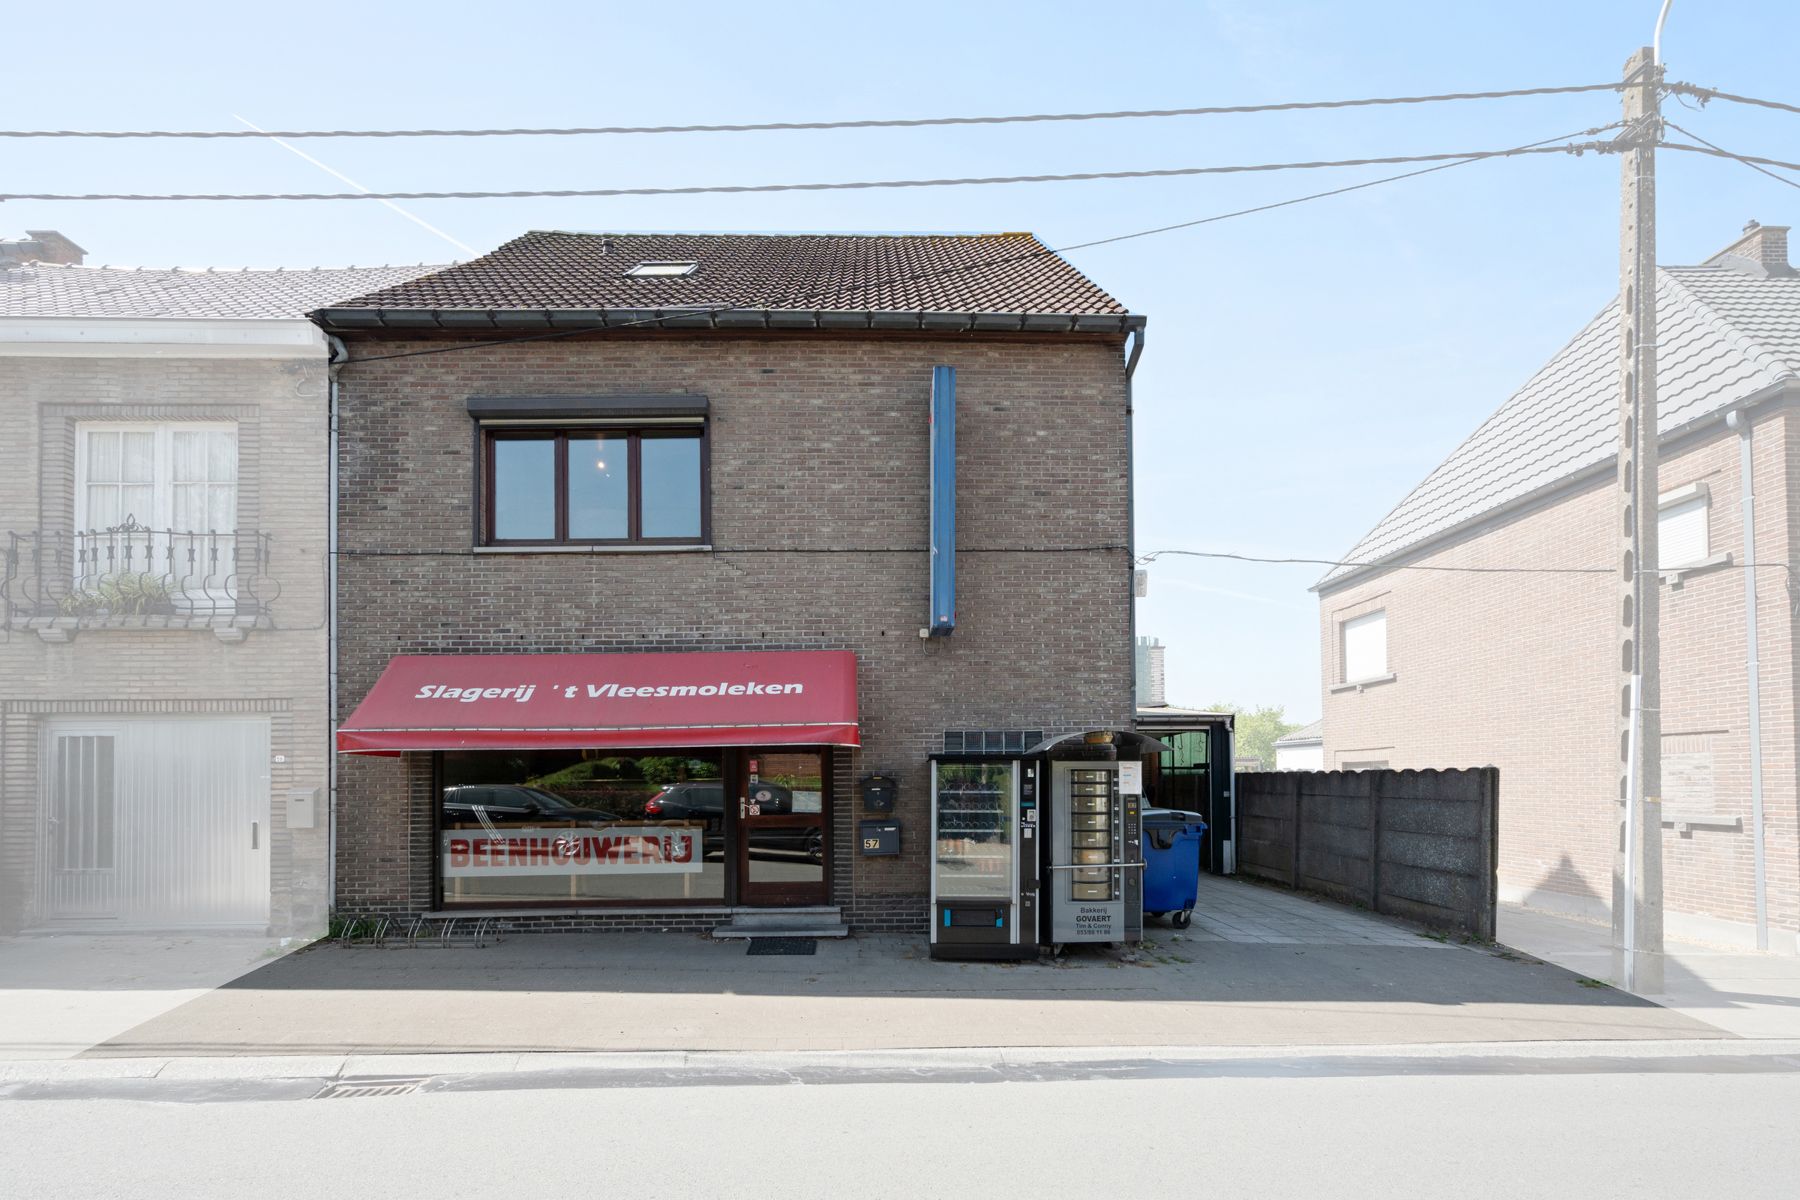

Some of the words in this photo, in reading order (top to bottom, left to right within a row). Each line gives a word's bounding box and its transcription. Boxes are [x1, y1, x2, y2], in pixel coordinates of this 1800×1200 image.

[415, 684, 537, 703] Slagerij
[586, 681, 804, 698] Vleesmoleken
[450, 835, 693, 868] BEENHOUWERIJ
[865, 839, 879, 849] 57
